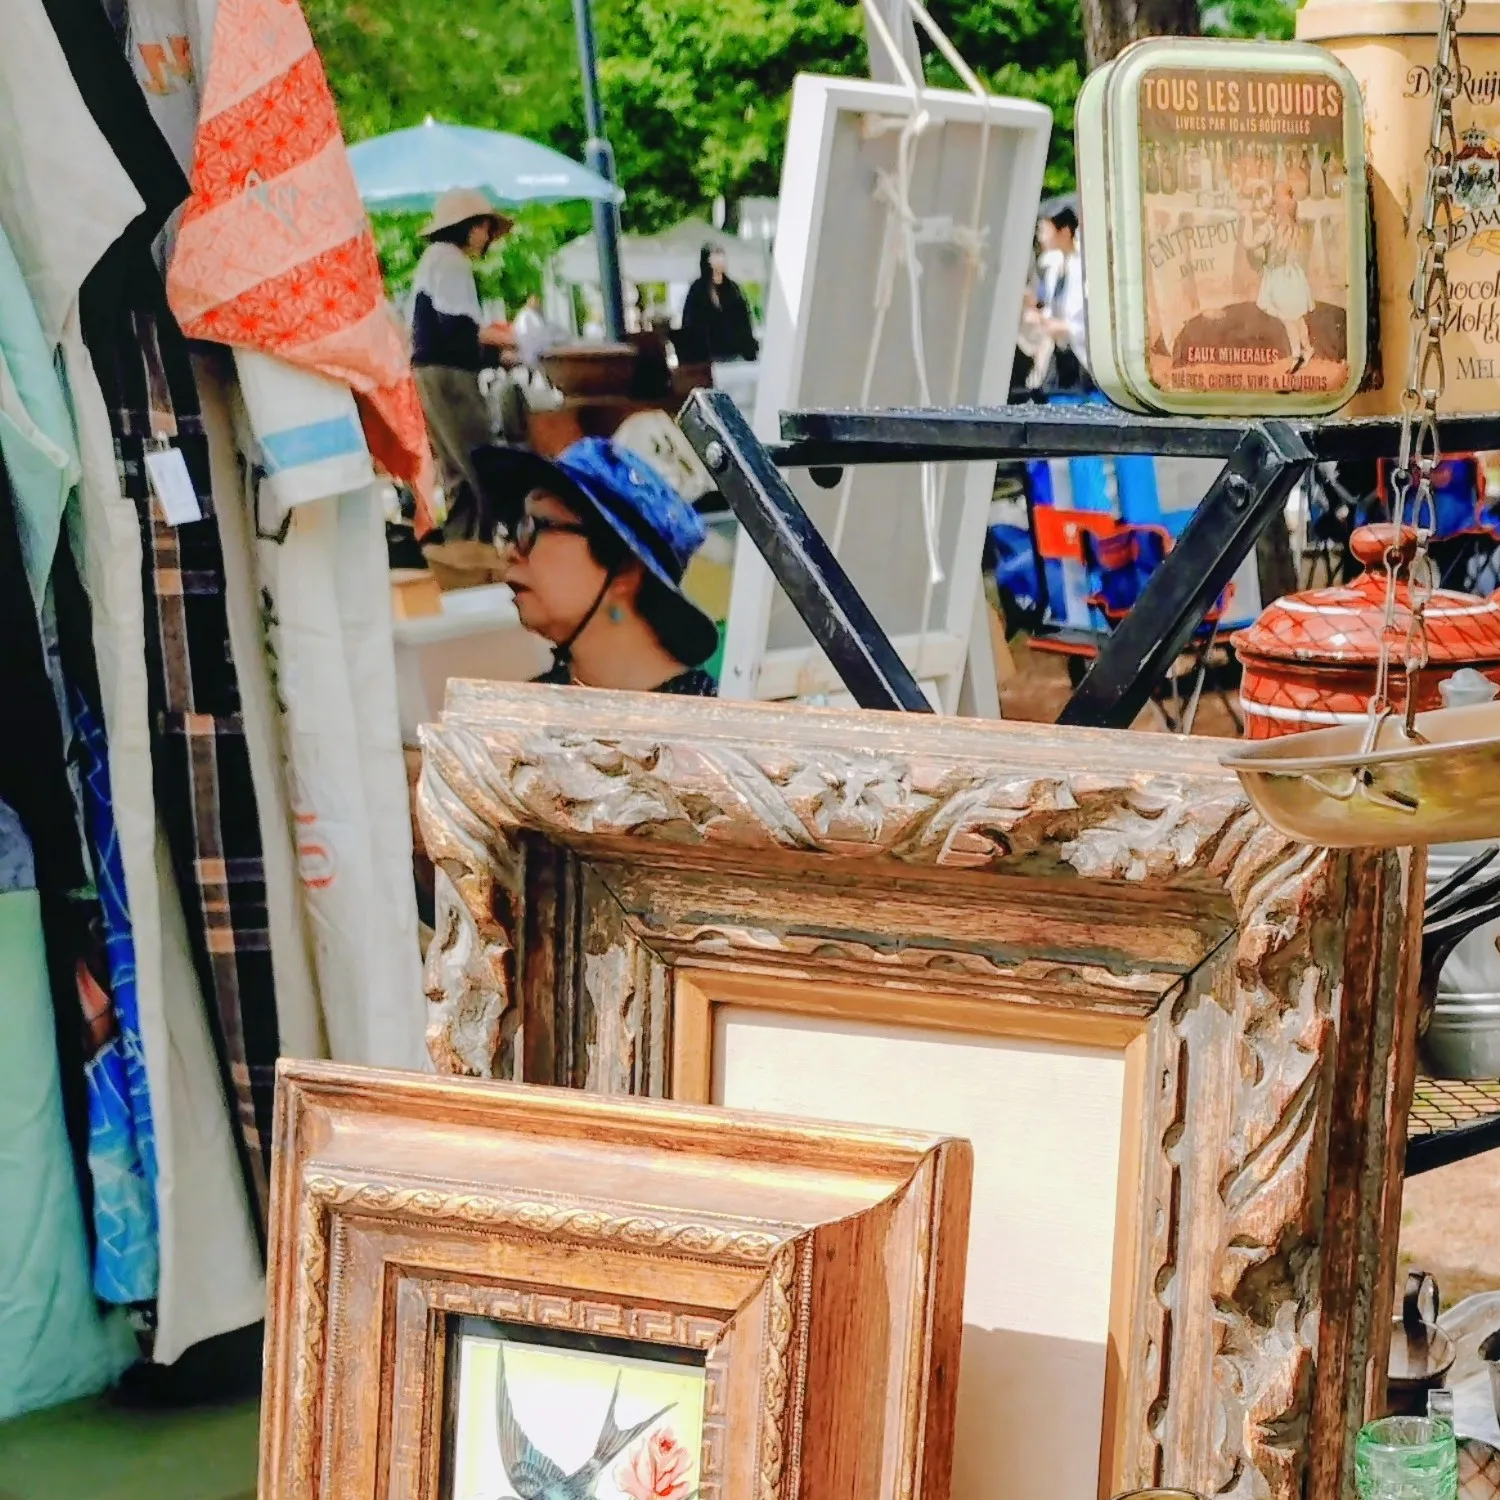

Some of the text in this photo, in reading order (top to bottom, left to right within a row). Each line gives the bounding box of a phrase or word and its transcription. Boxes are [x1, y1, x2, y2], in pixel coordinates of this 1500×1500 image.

[1143, 78, 1341, 118] TOUS LES LIQUIDES
[1208, 118, 1226, 132] PAR
[1187, 346, 1216, 362] EAUX
